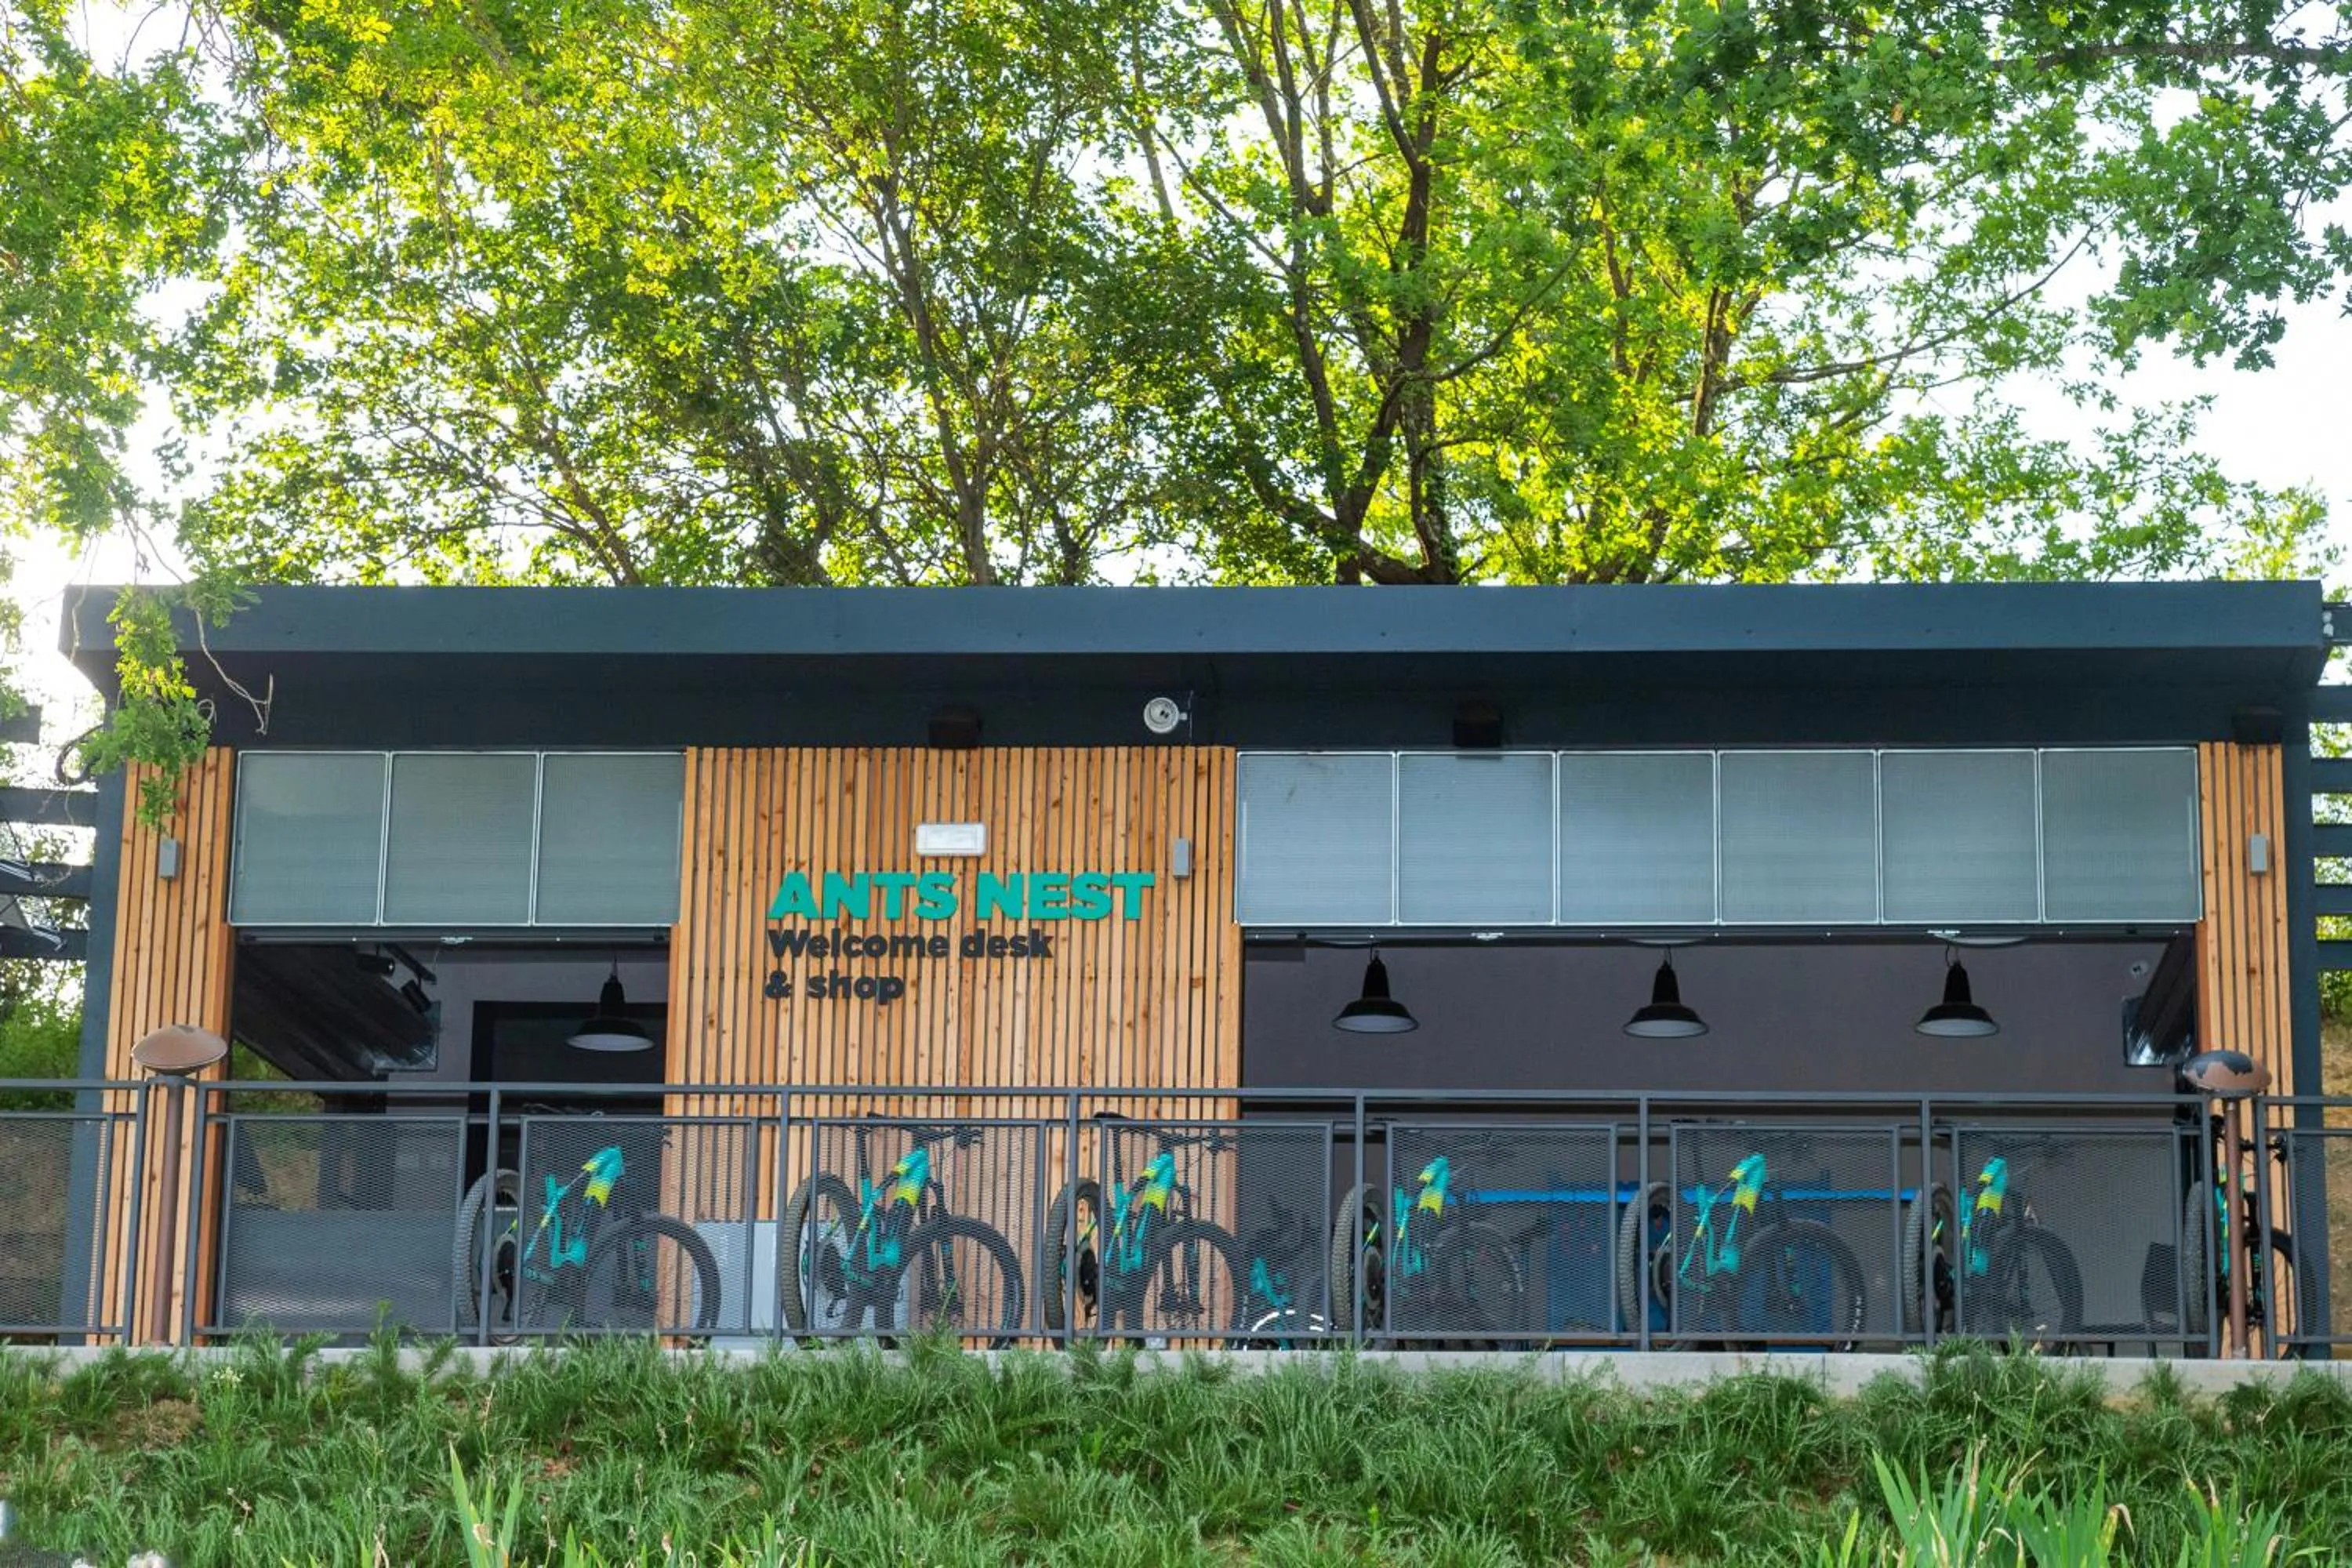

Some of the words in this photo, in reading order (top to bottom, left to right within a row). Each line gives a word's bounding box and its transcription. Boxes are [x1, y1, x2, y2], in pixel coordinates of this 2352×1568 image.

[768, 871, 957, 920] ANTS
[975, 871, 1156, 920] NEST
[768, 928, 950, 958] Welcome
[961, 928, 1054, 958] desk
[764, 970, 791, 1000] &
[806, 969, 904, 1005] shop
